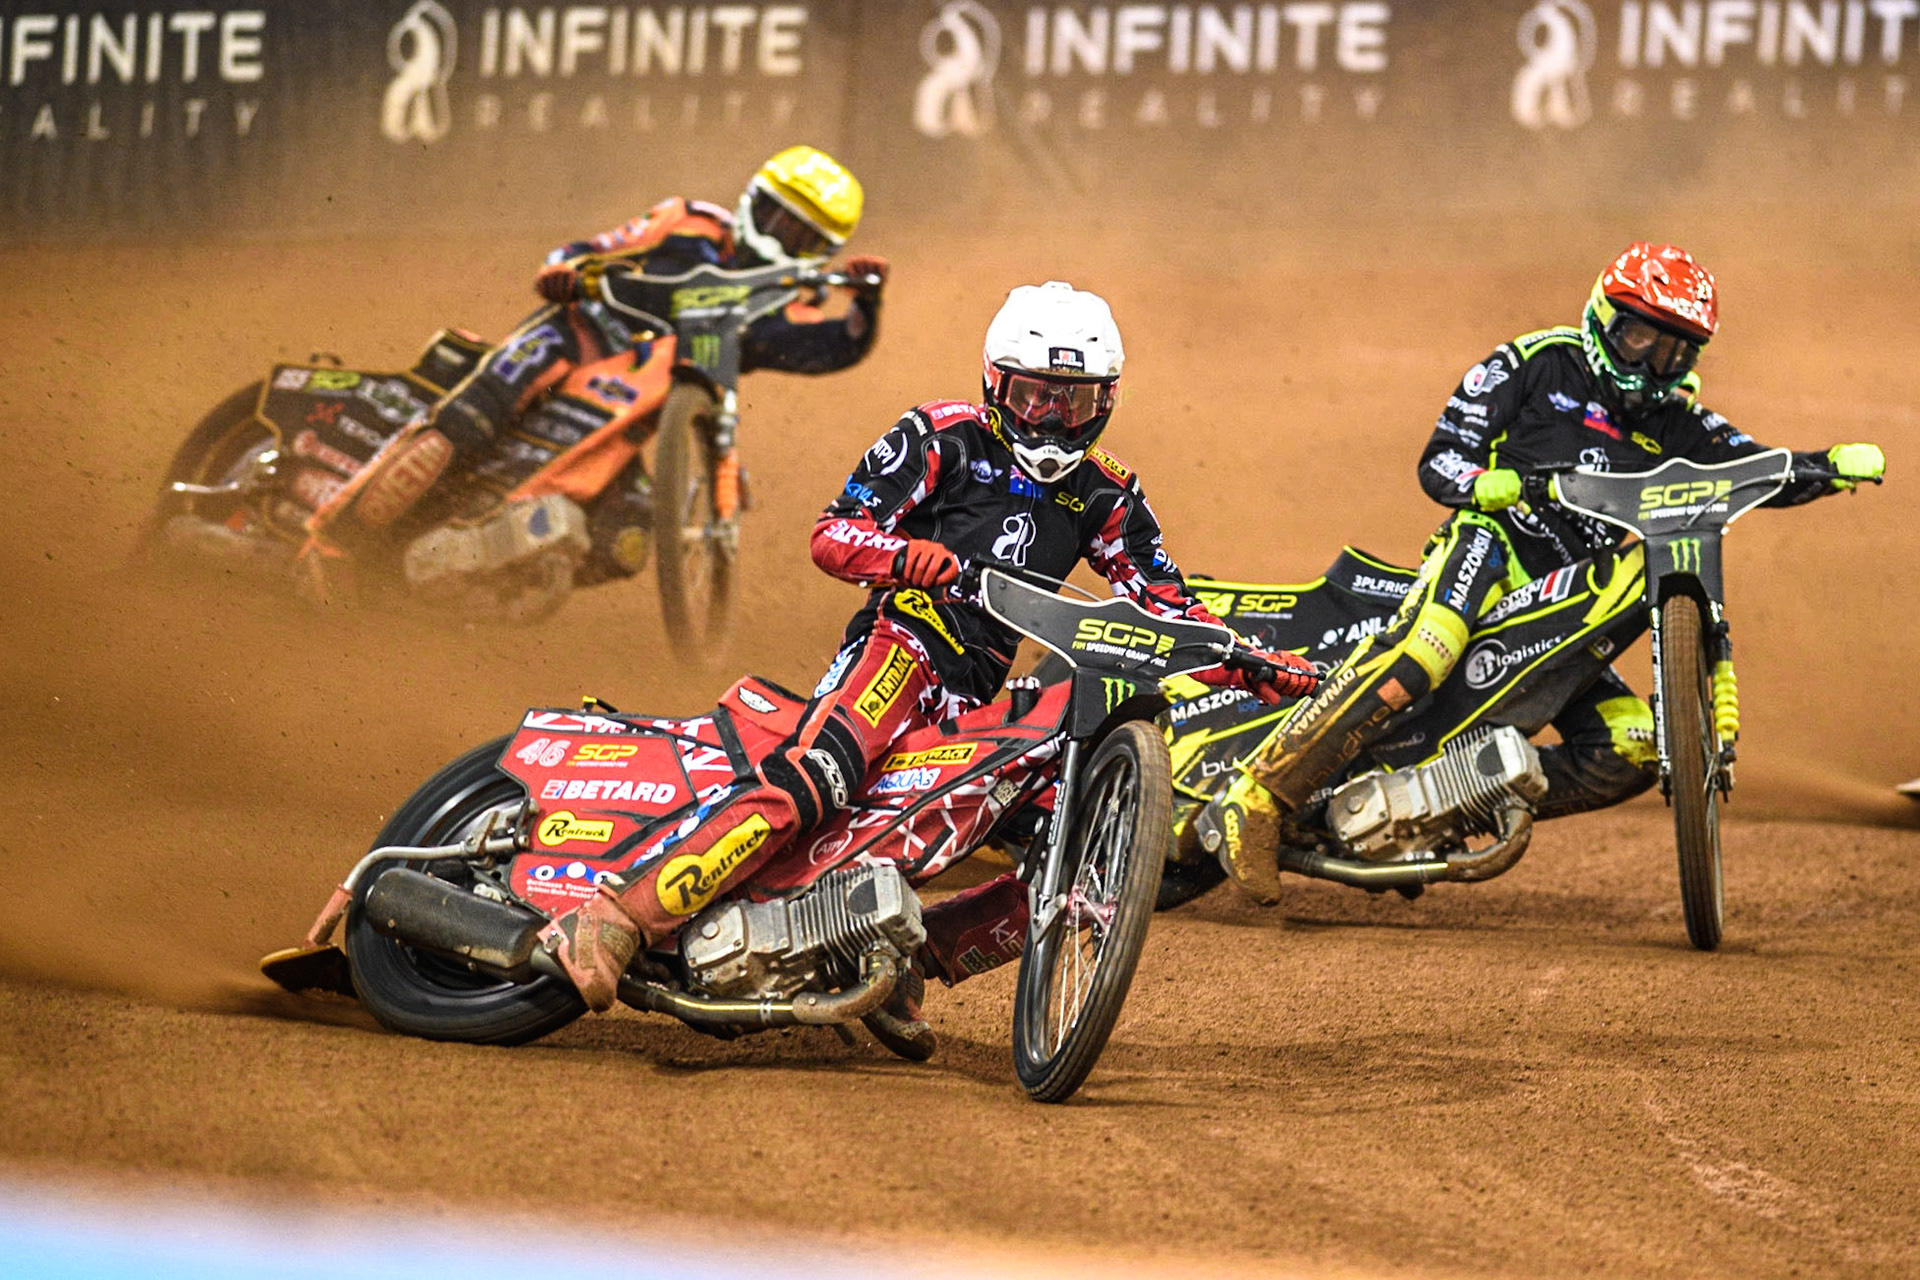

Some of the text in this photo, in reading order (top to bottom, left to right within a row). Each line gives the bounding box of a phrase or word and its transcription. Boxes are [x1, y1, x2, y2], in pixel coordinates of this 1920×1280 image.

[0, 10, 266, 87] FINITE
[479, 4, 809, 77] INFINITE
[1024, 2, 1391, 76] INFINITE
[1639, 481, 1714, 510] SGP
[1236, 594, 1298, 612] SGP
[1074, 618, 1158, 648] SGP
[1086, 642, 1127, 657] SPEEDWAY
[875, 646, 914, 700] ENTRACK
[516, 738, 571, 767] 46
[573, 744, 639, 761] SGP
[562, 779, 676, 804] BETARD
[545, 819, 606, 837] Rentruck
[665, 829, 766, 908] Rentruck
